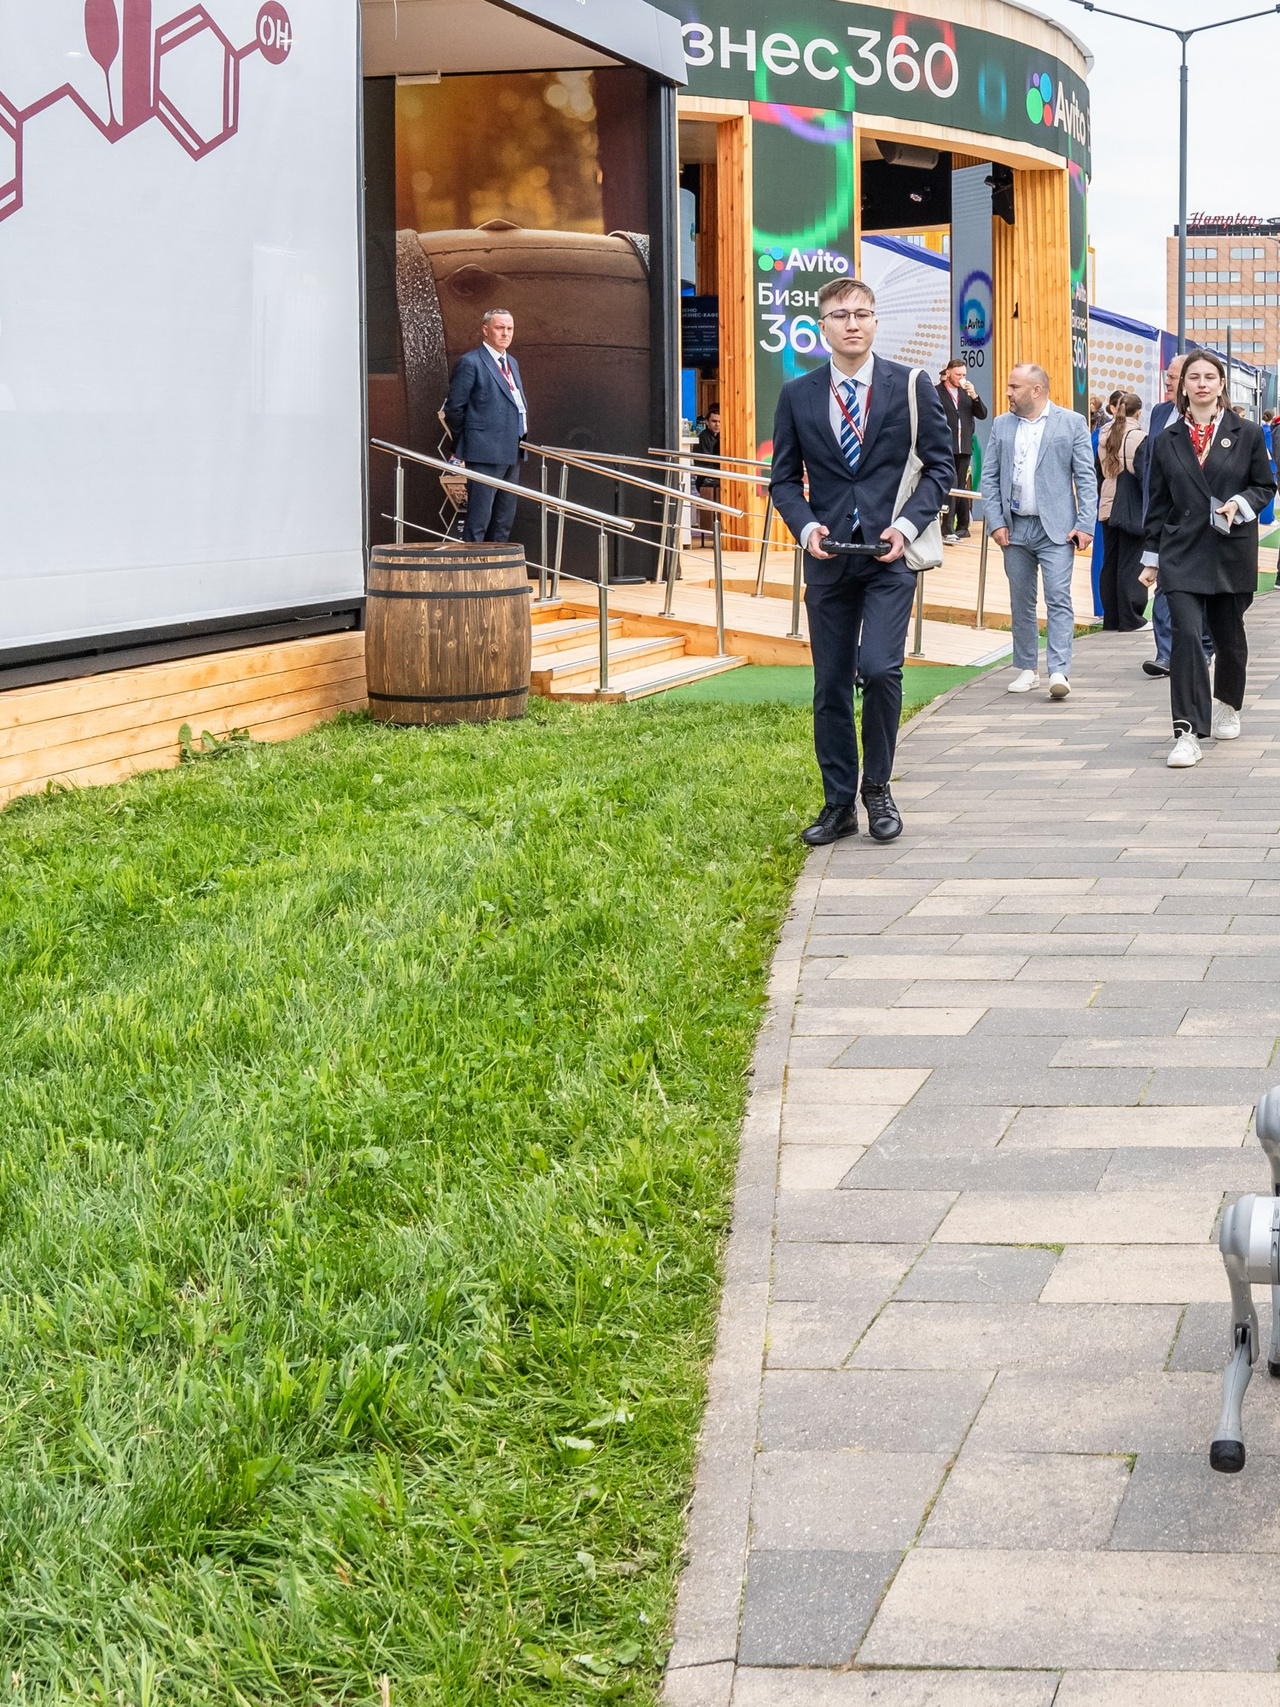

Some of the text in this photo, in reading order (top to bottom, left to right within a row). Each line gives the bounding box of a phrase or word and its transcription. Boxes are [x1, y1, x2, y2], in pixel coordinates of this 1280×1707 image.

[260, 15, 289, 51] OH
[681, 22, 959, 98] знес360
[1053, 80, 1086, 146] Avito
[1189, 211, 1263, 229] Hampton
[785, 247, 849, 274] Avito
[758, 282, 819, 307] Бизн
[968, 318, 985, 329] Avito
[960, 336, 985, 347] Бизнес
[1072, 335, 1087, 369] 360
